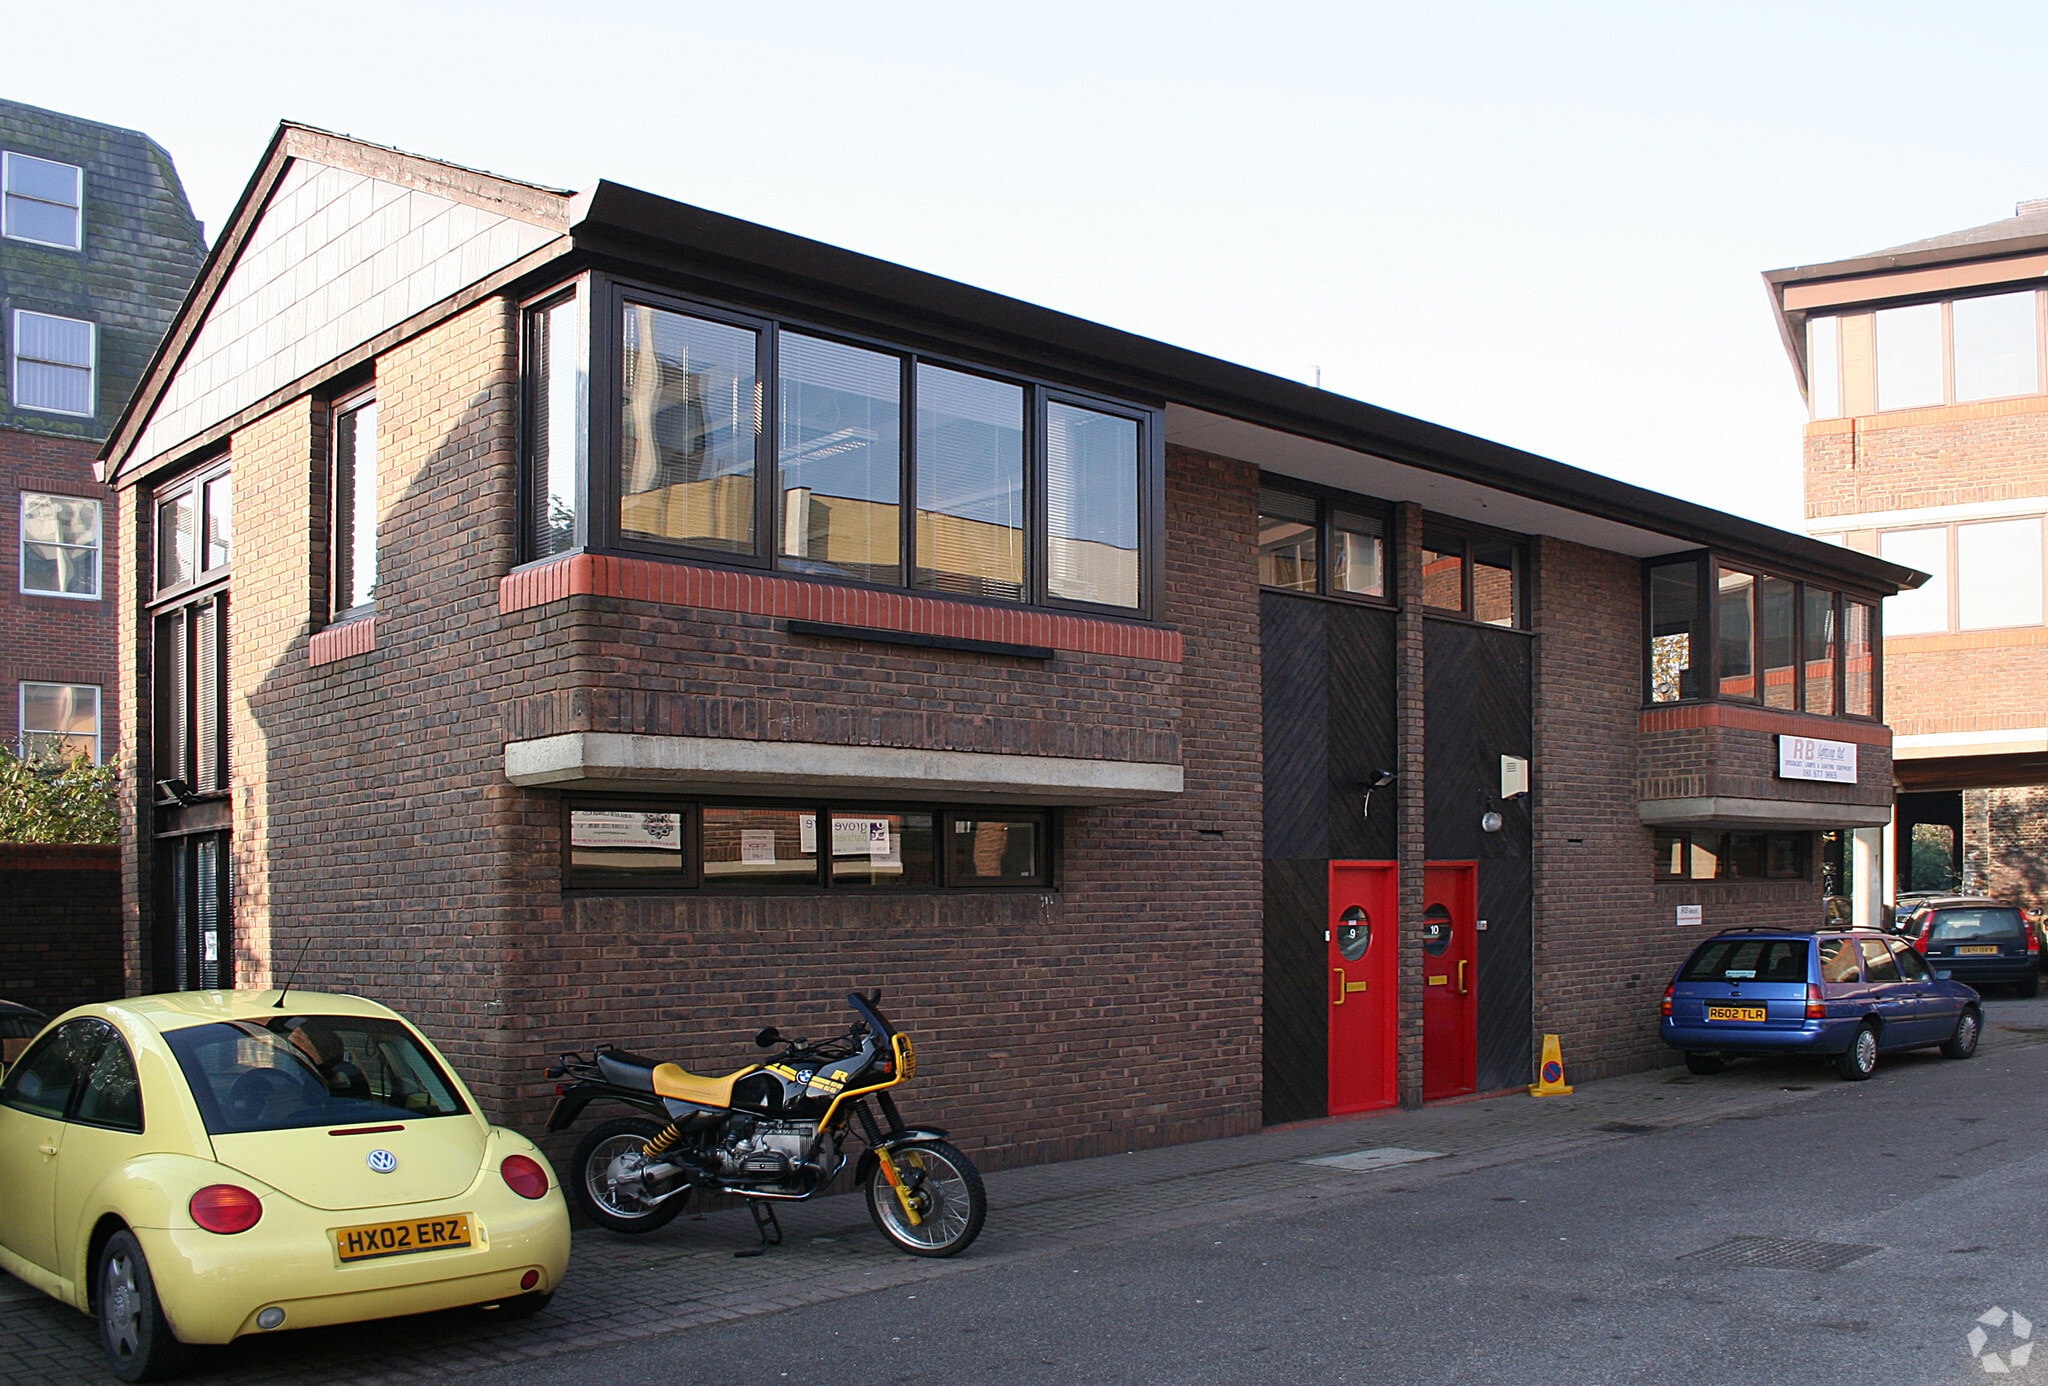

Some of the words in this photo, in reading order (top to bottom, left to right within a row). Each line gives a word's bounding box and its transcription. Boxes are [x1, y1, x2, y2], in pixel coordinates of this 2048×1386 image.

[1793, 739, 1814, 760] RB
[1350, 928, 1356, 939] 9
[1430, 925, 1439, 935] 10
[1710, 1008, 1739, 1018] R602
[1741, 1009, 1763, 1019] TLR
[831, 1069, 849, 1083] R
[347, 1226, 412, 1253] HX02
[416, 1220, 461, 1244] ERZ
